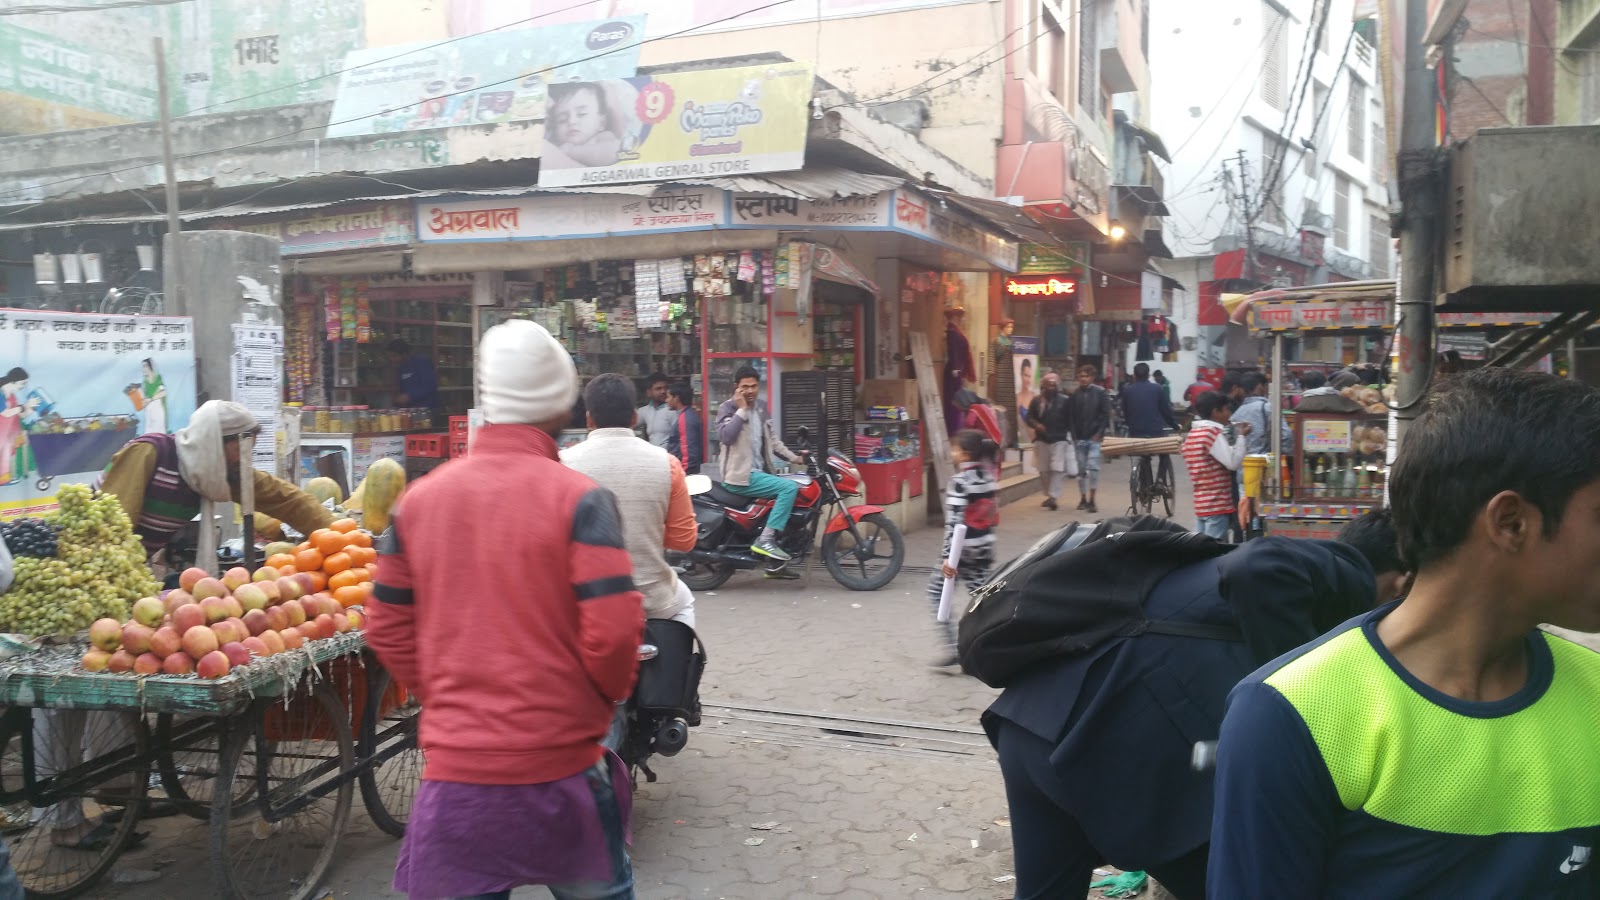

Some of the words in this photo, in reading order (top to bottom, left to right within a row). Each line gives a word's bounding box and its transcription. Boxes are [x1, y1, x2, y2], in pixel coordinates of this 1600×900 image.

[590, 30, 627, 43] Paras
[580, 164, 652, 183] AGGARWAL
[654, 160, 705, 178] GENRAL
[708, 159, 751, 174] STORE
[428, 207, 521, 234] अग्रवाल
